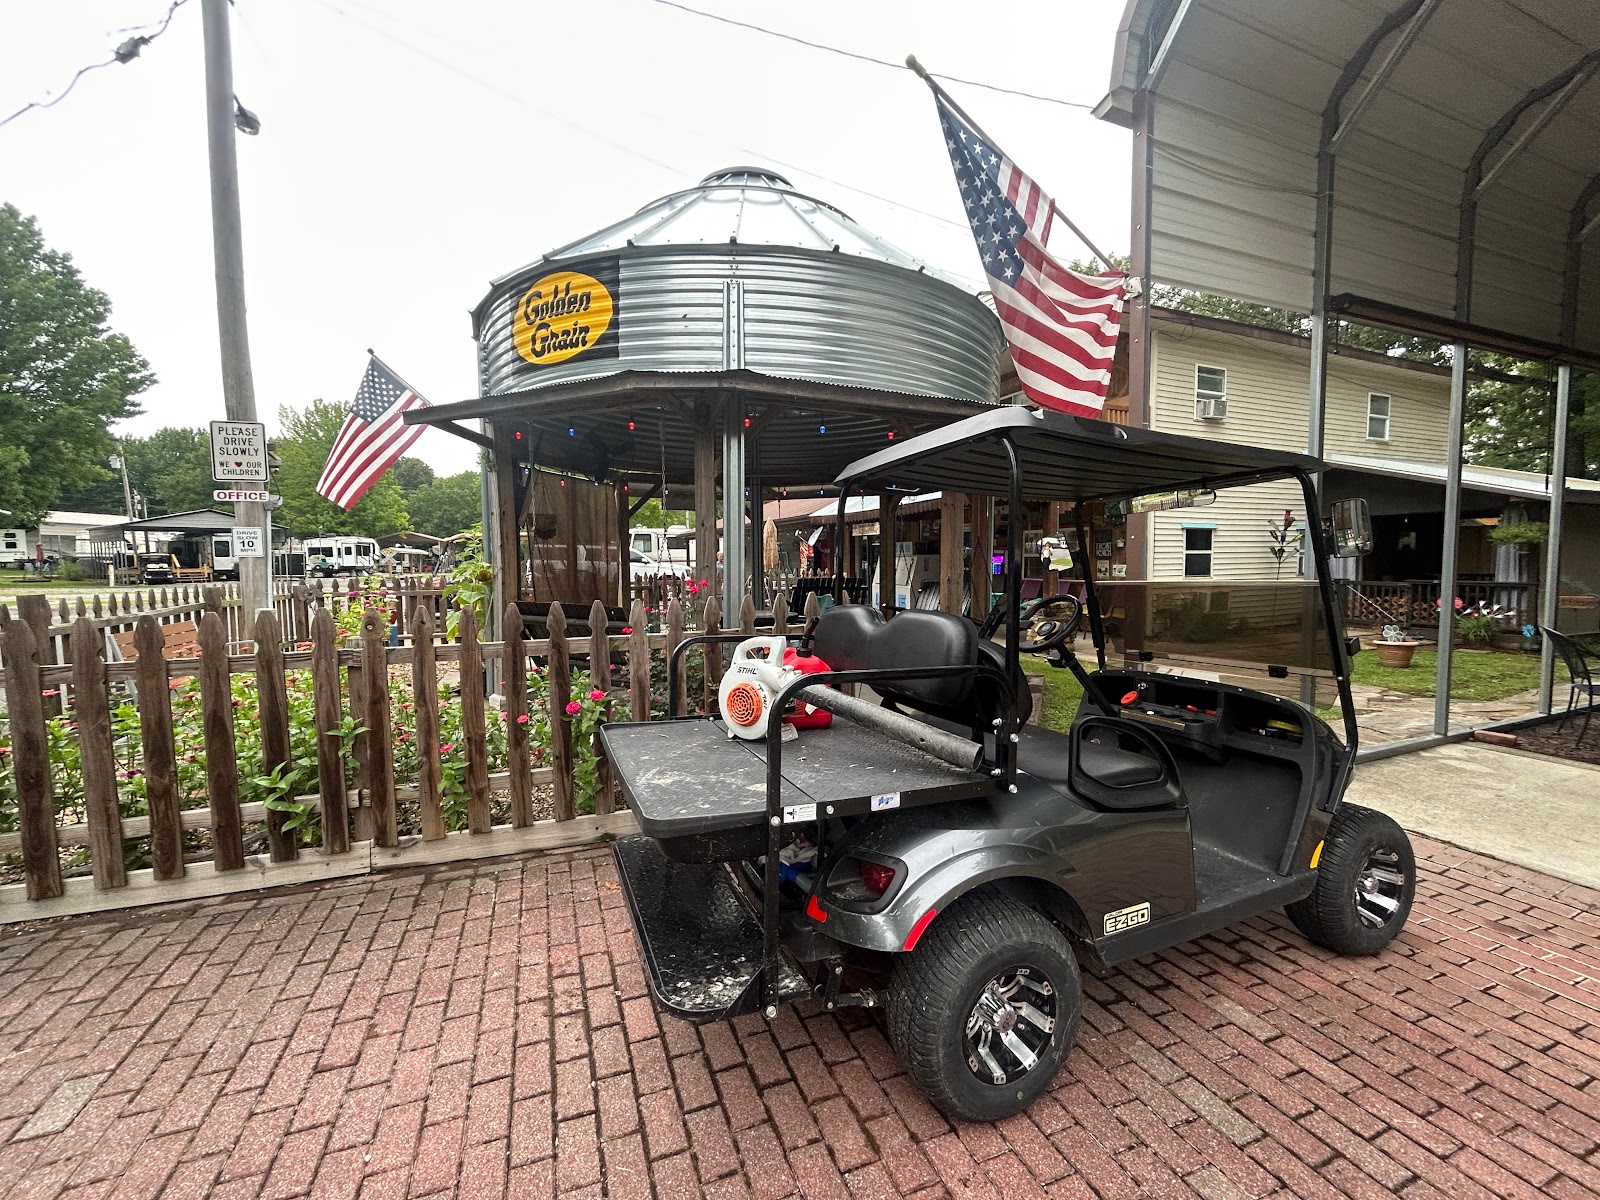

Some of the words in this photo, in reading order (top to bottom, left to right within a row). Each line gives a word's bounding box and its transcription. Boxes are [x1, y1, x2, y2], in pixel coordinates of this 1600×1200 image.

[524, 281, 591, 326] Golden
[531, 320, 590, 357] Grain
[218, 427, 258, 437] PLEASE
[223, 437, 254, 447] DRIVE
[219, 447, 259, 457] SLOWLY
[246, 461, 262, 469] OUR
[222, 468, 260, 476] CHILDREN
[216, 491, 267, 501] OFFICE
[240, 540, 255, 548] 10
[737, 666, 757, 675] STIHL
[1105, 908, 1149, 933] EZGO
